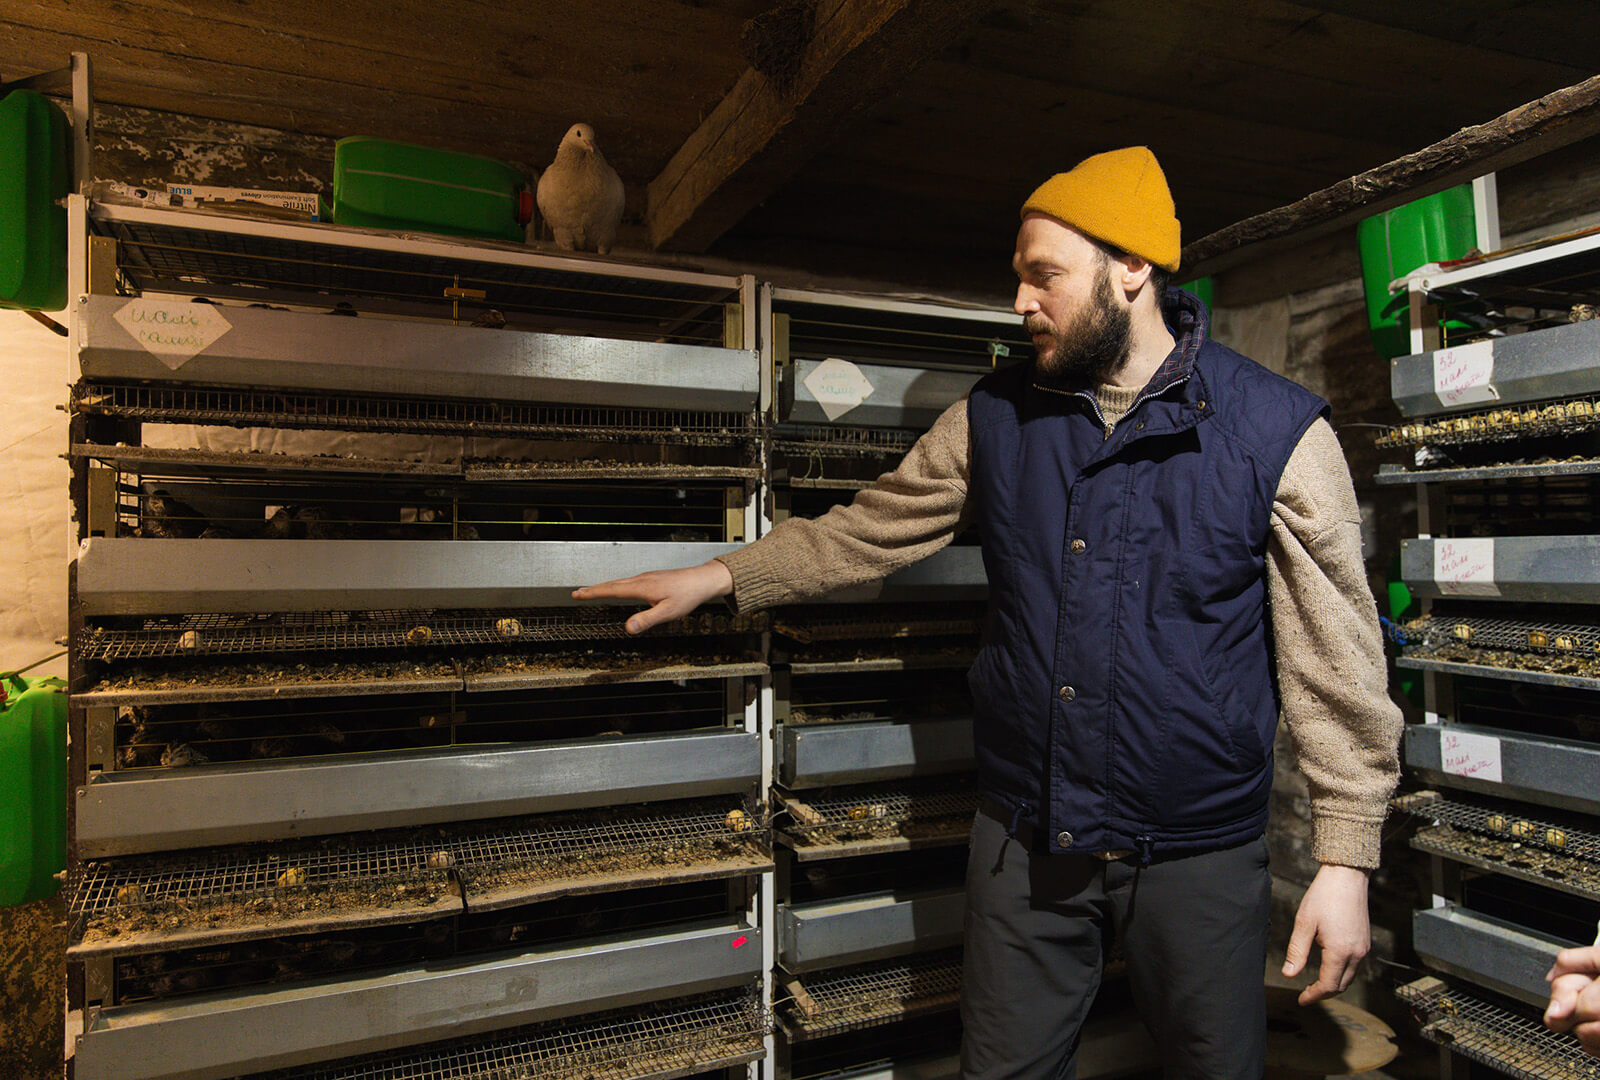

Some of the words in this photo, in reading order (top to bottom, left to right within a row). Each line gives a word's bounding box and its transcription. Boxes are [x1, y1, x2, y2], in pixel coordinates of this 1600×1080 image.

[169, 186, 192, 195] BLUE
[240, 191, 262, 199] Gloves
[262, 192, 301, 202] Examination
[302, 195, 316, 203] Soft
[282, 200, 316, 213] Nitrile
